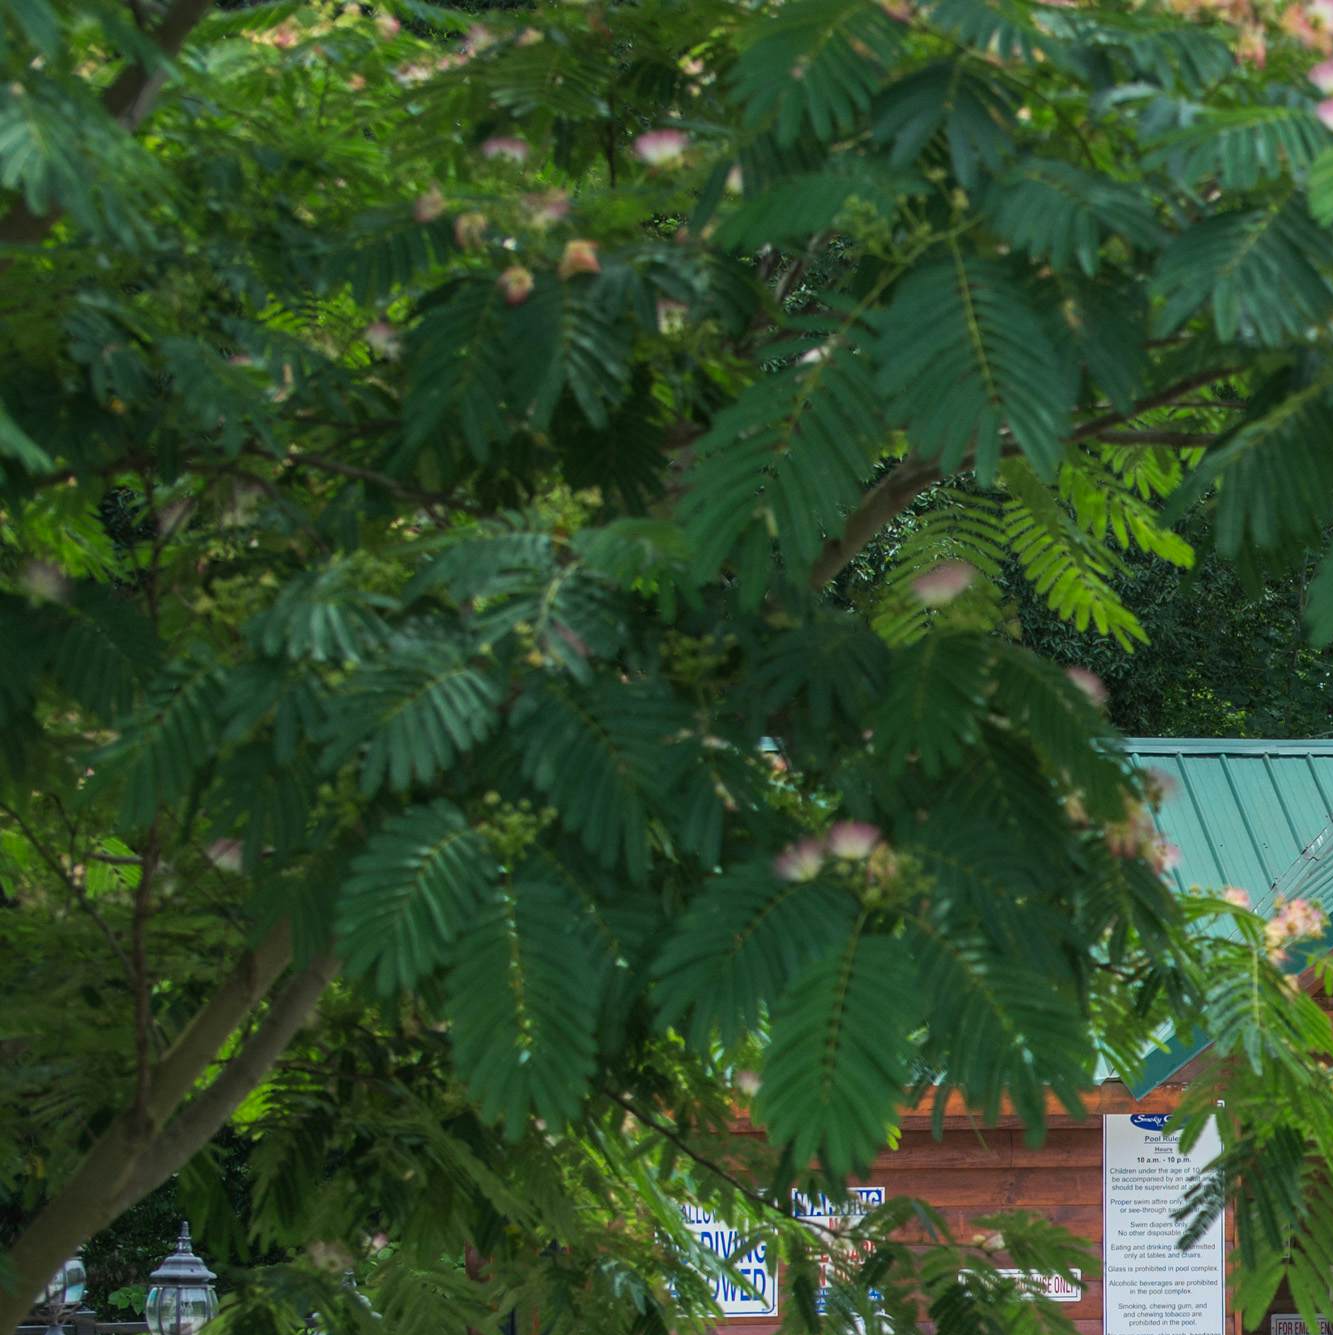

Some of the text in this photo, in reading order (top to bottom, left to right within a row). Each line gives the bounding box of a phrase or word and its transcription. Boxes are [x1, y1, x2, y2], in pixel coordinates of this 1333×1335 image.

[1121, 1176, 1164, 1184] accompanied
[1165, 1175, 1174, 1183] by
[1110, 1198, 1132, 1206] Proper
[1135, 1265, 1167, 1273] prohibited
[1175, 1265, 1190, 1273] pool
[706, 1268, 767, 1302] OWED
[1186, 1279, 1218, 1287] prohibited
[1149, 1302, 1176, 1310] chewing
[1278, 1321, 1293, 1335] FOR
